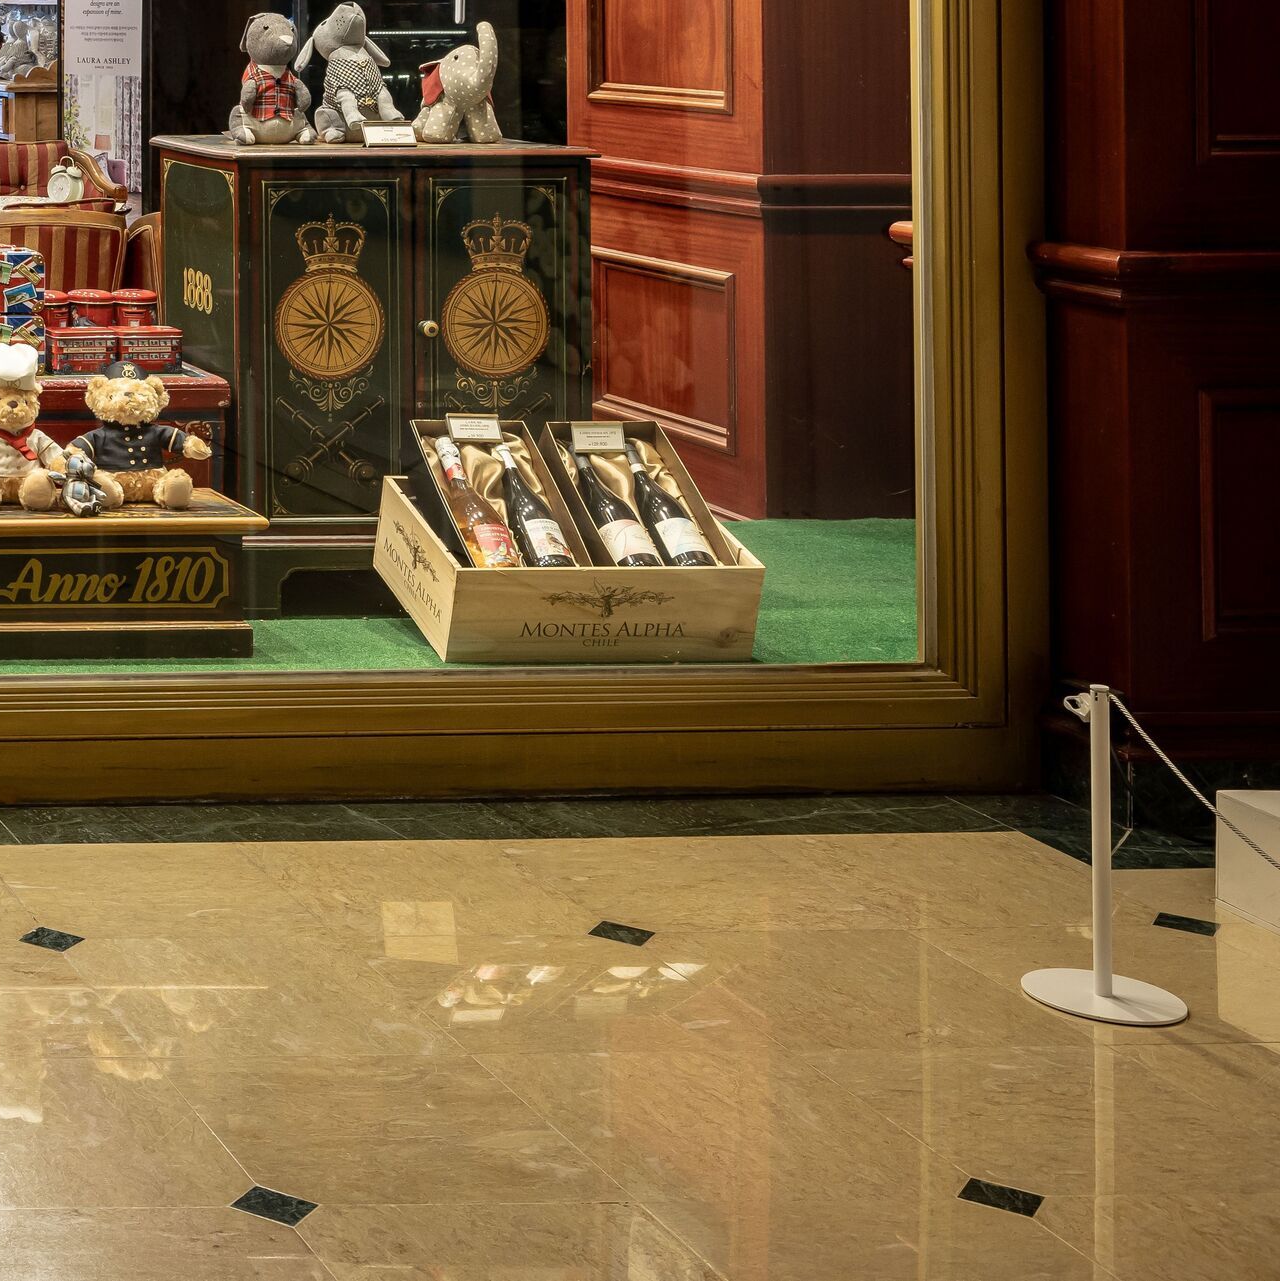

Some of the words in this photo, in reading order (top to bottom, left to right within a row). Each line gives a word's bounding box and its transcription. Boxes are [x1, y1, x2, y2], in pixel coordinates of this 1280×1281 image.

[103, 57, 131, 65] ASHLEY
[183, 267, 213, 315] 1888
[128, 556, 215, 602] 1810
[384, 537, 416, 588] MONTES
[416, 581, 444, 624] ALPHA
[519, 621, 611, 638] MONTES
[616, 621, 685, 638] ALPHA
[582, 638, 620, 647] CHILE
